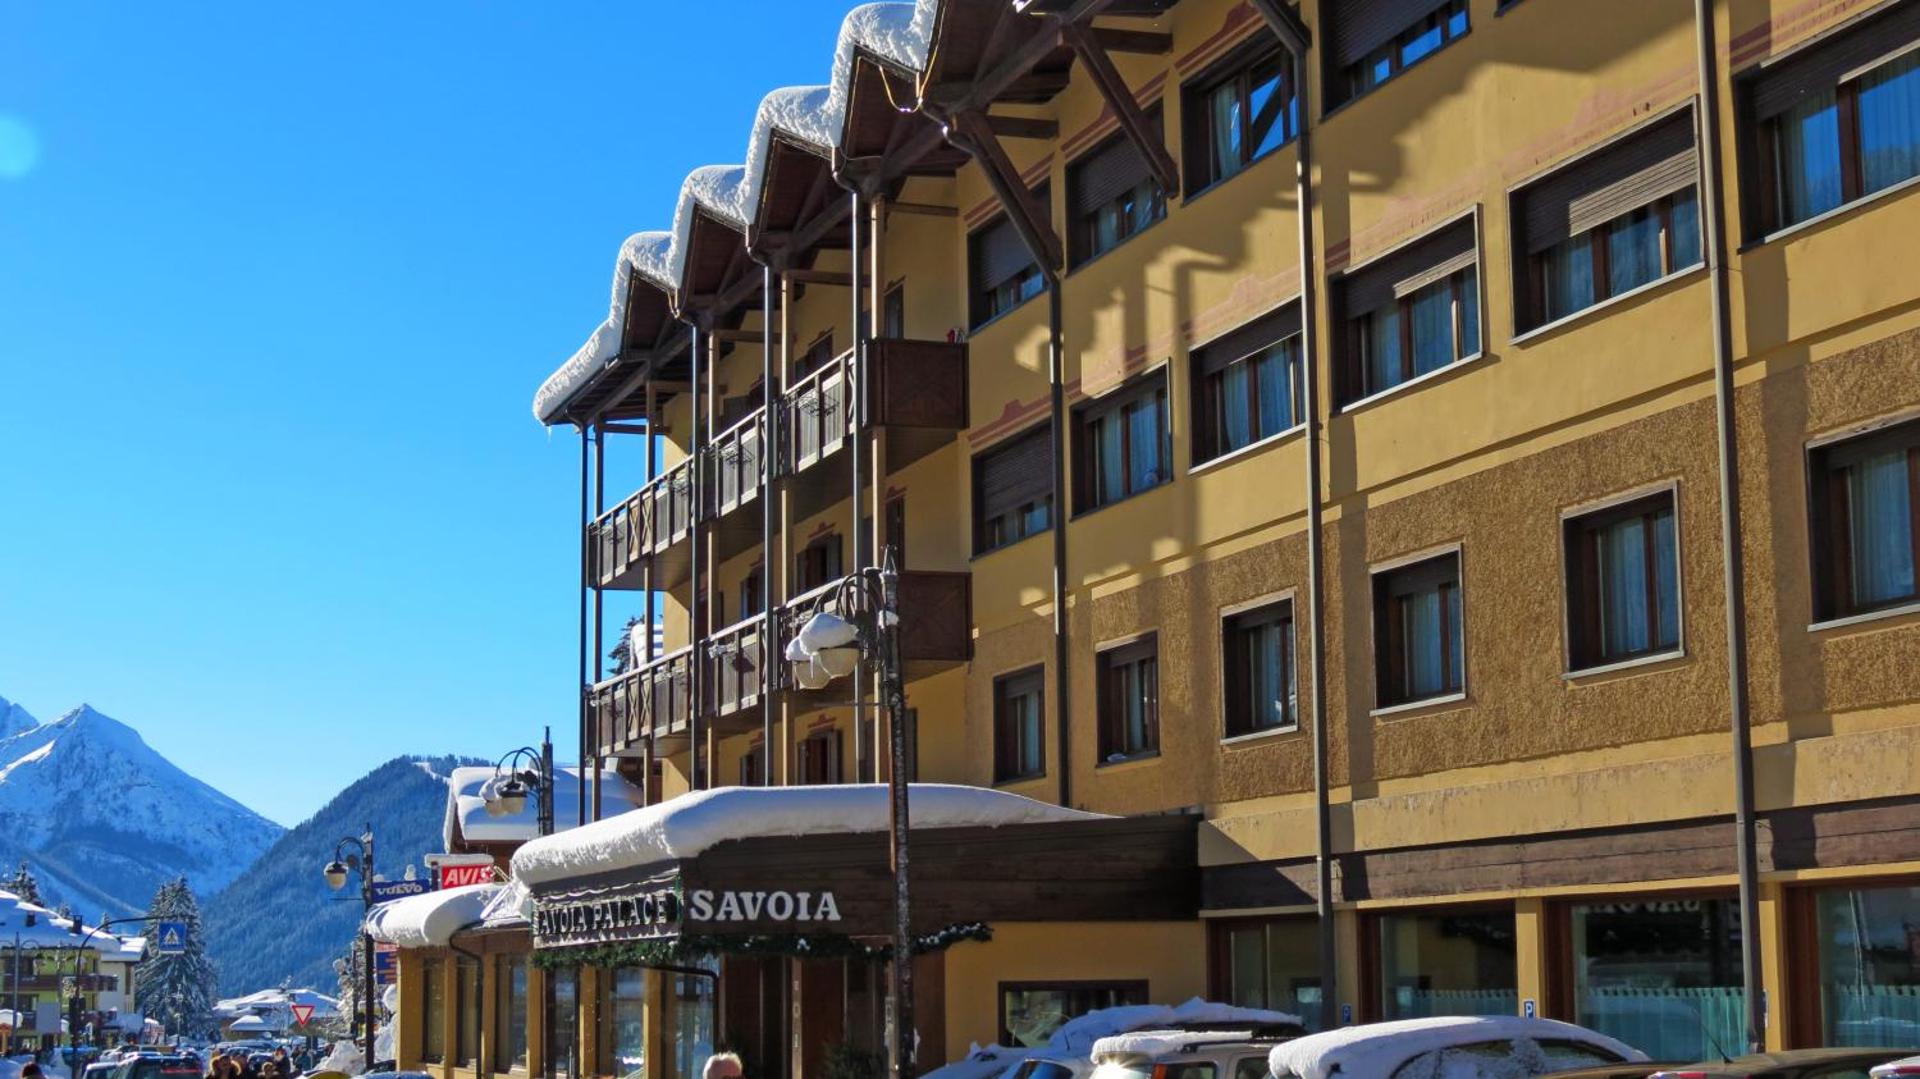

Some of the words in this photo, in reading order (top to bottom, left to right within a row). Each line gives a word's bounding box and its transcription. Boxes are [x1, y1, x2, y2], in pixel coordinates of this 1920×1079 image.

[534, 904, 587, 934] AVOIA
[592, 894, 666, 930] PALACE
[690, 889, 842, 921] SAVOIA
[1525, 1002, 1534, 1019] P
